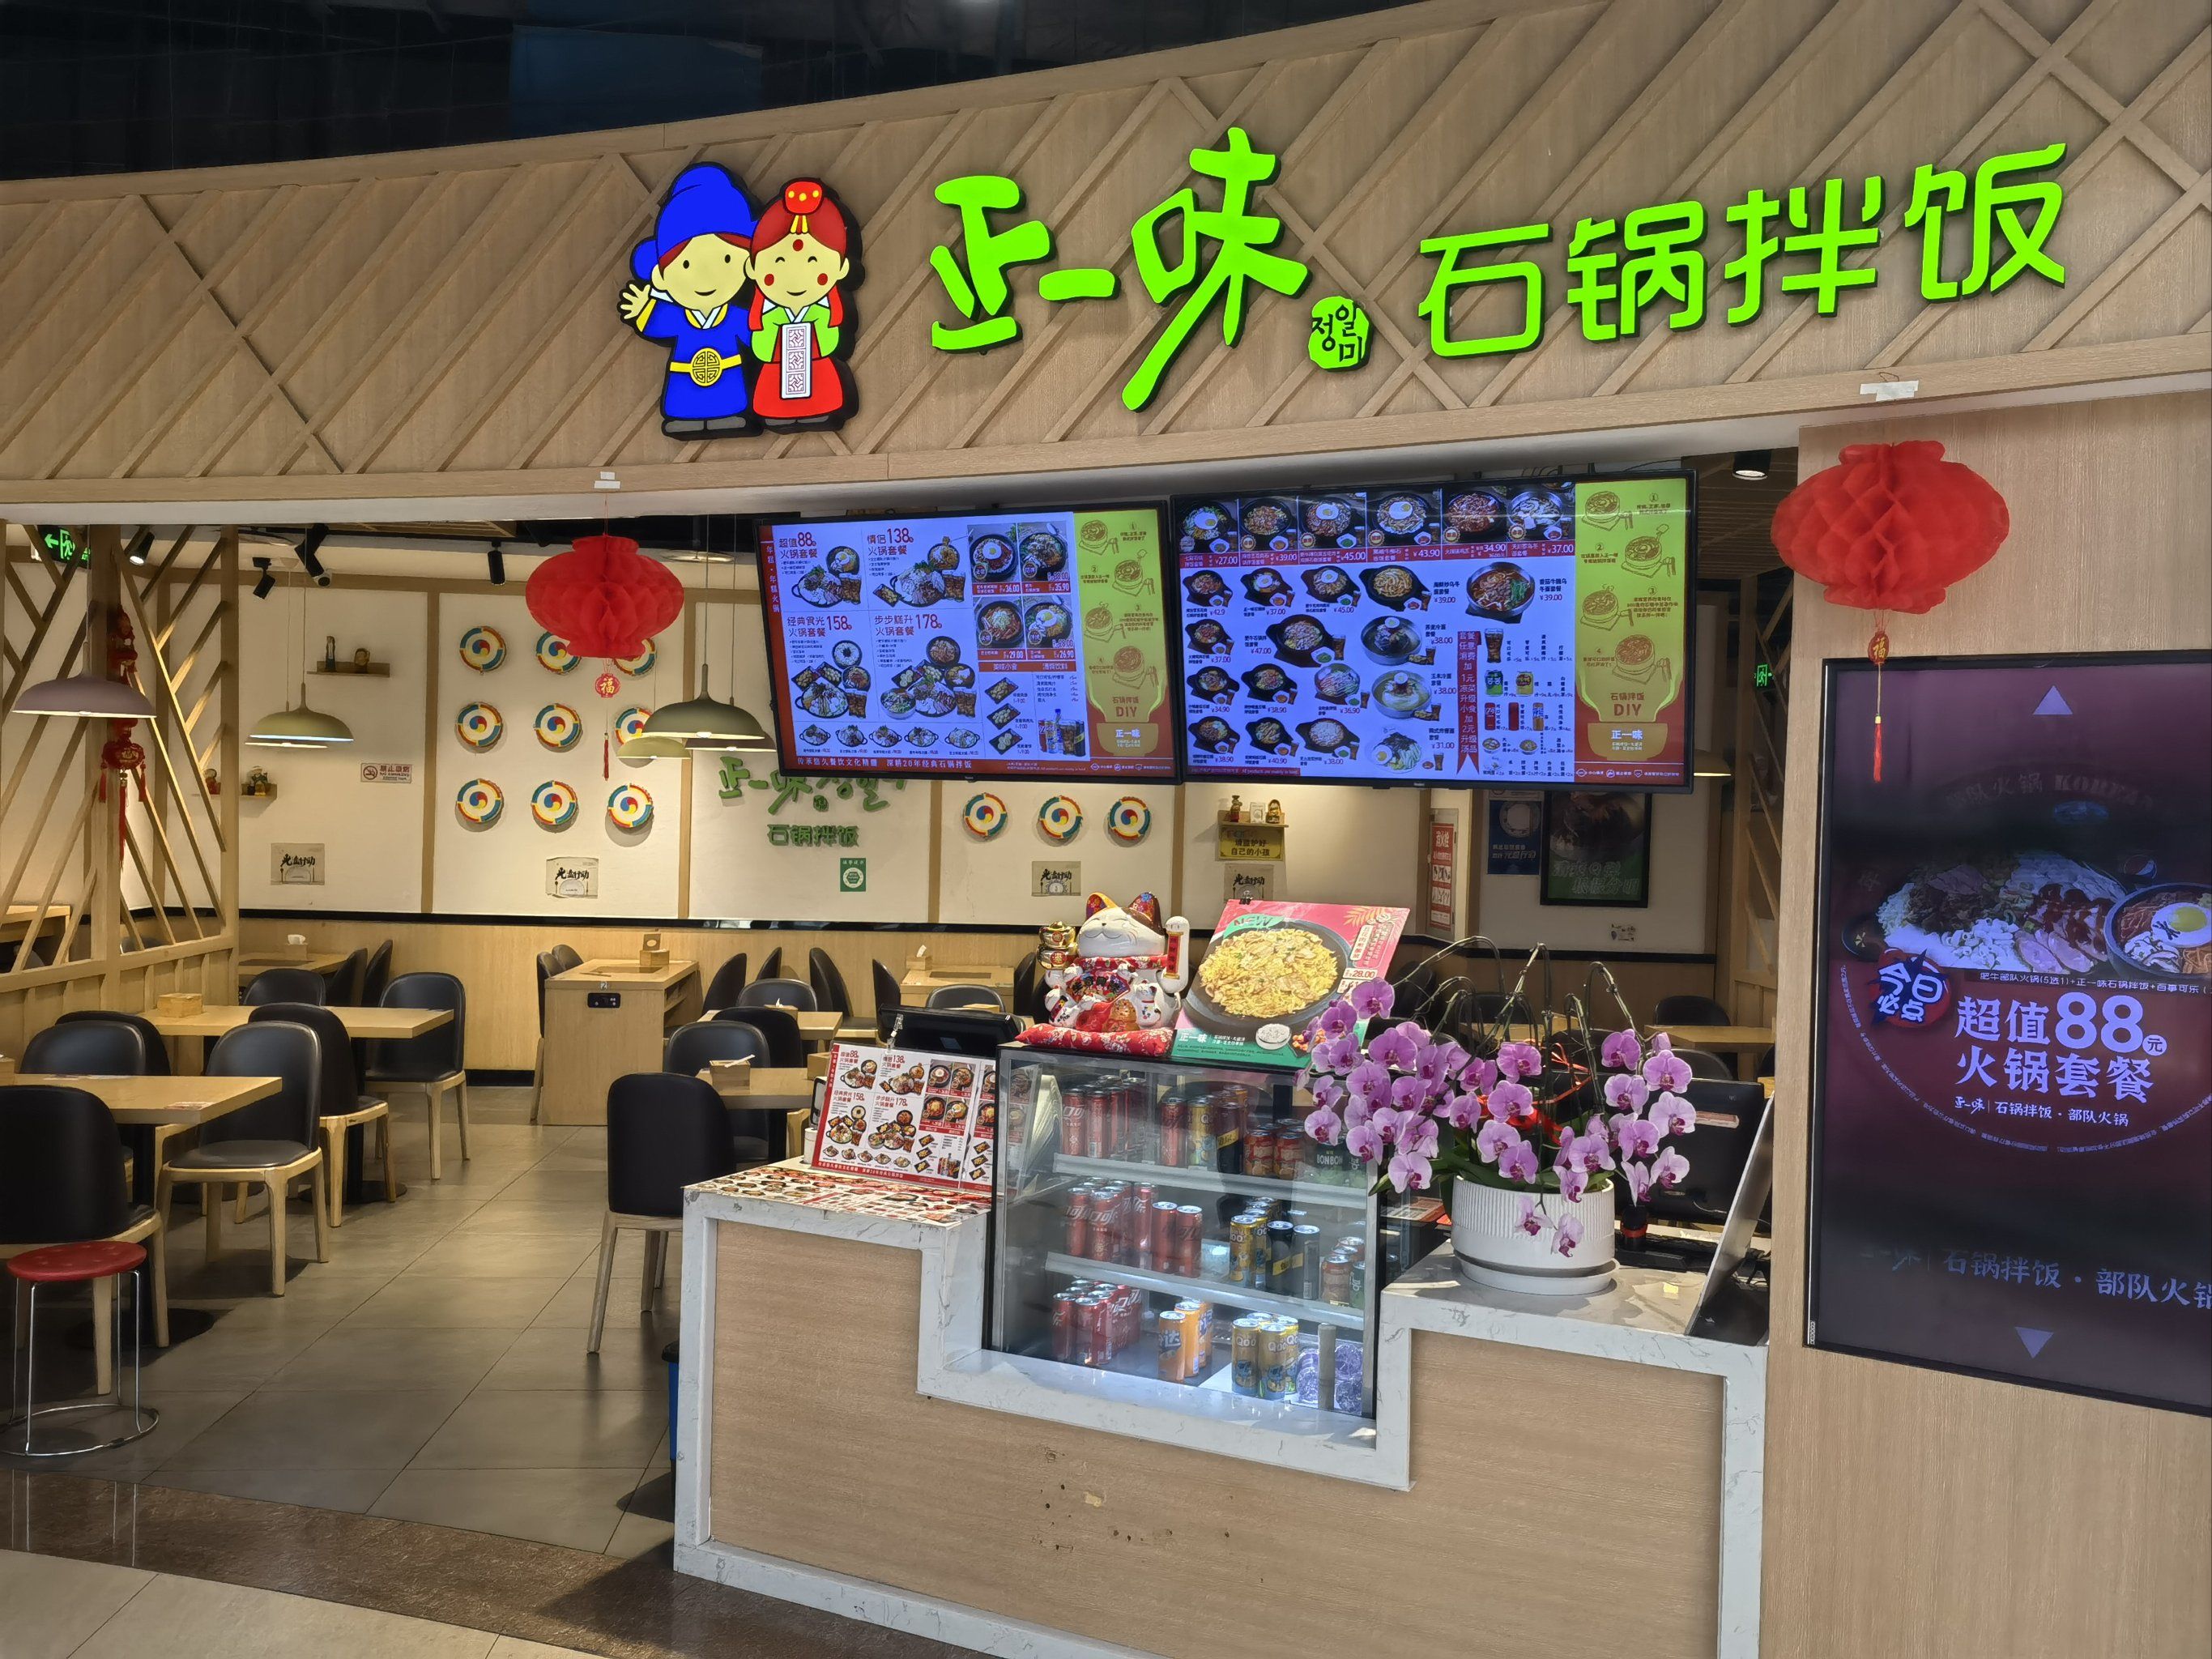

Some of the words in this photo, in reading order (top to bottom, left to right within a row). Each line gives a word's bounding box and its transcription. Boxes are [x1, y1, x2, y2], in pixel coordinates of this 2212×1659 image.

[1417, 143, 2069, 359] 石锅拌饭
[930, 126, 1310, 412] 正一味
[1311, 303, 1363, 365] 정일미
[868, 545, 908, 557] 火锅套餐
[1413, 549, 1440, 557] ¥43.90
[1483, 544, 1506, 552] 34.90
[1548, 544, 1574, 553] ¥37.00
[781, 548, 818, 559] 火锅套餐
[1276, 553, 1297, 561] ¥39.00
[1340, 552, 1366, 561] ¥45.00
[1215, 555, 1238, 565] ¥27.00
[789, 628, 826, 638] 火锅套餐
[876, 626, 915, 637] 火锅套餐
[1873, 637, 1886, 659] 福
[599, 677, 615, 694] 福
[1610, 693, 1644, 701] 石锅拌饭
[1115, 706, 1137, 717] DIY
[1613, 703, 1642, 717] DIY
[1115, 729, 1140, 738] 正一味
[1611, 730, 1643, 740] 正一味
[767, 824, 859, 847] 石锅拌饭
[1231, 847, 1270, 856] 自己的小孩
[1234, 916, 1273, 926] NEW
[1179, 1033, 1208, 1043] 正一味
[1954, 1045, 2154, 1104] 火锅套餐
[1954, 1095, 1985, 1115] 正一味
[1316, 1154, 1343, 1164] BONBON
[1944, 1250, 2062, 1289] 石锅拌饭
[1236, 1336, 1257, 1346] Qoo
